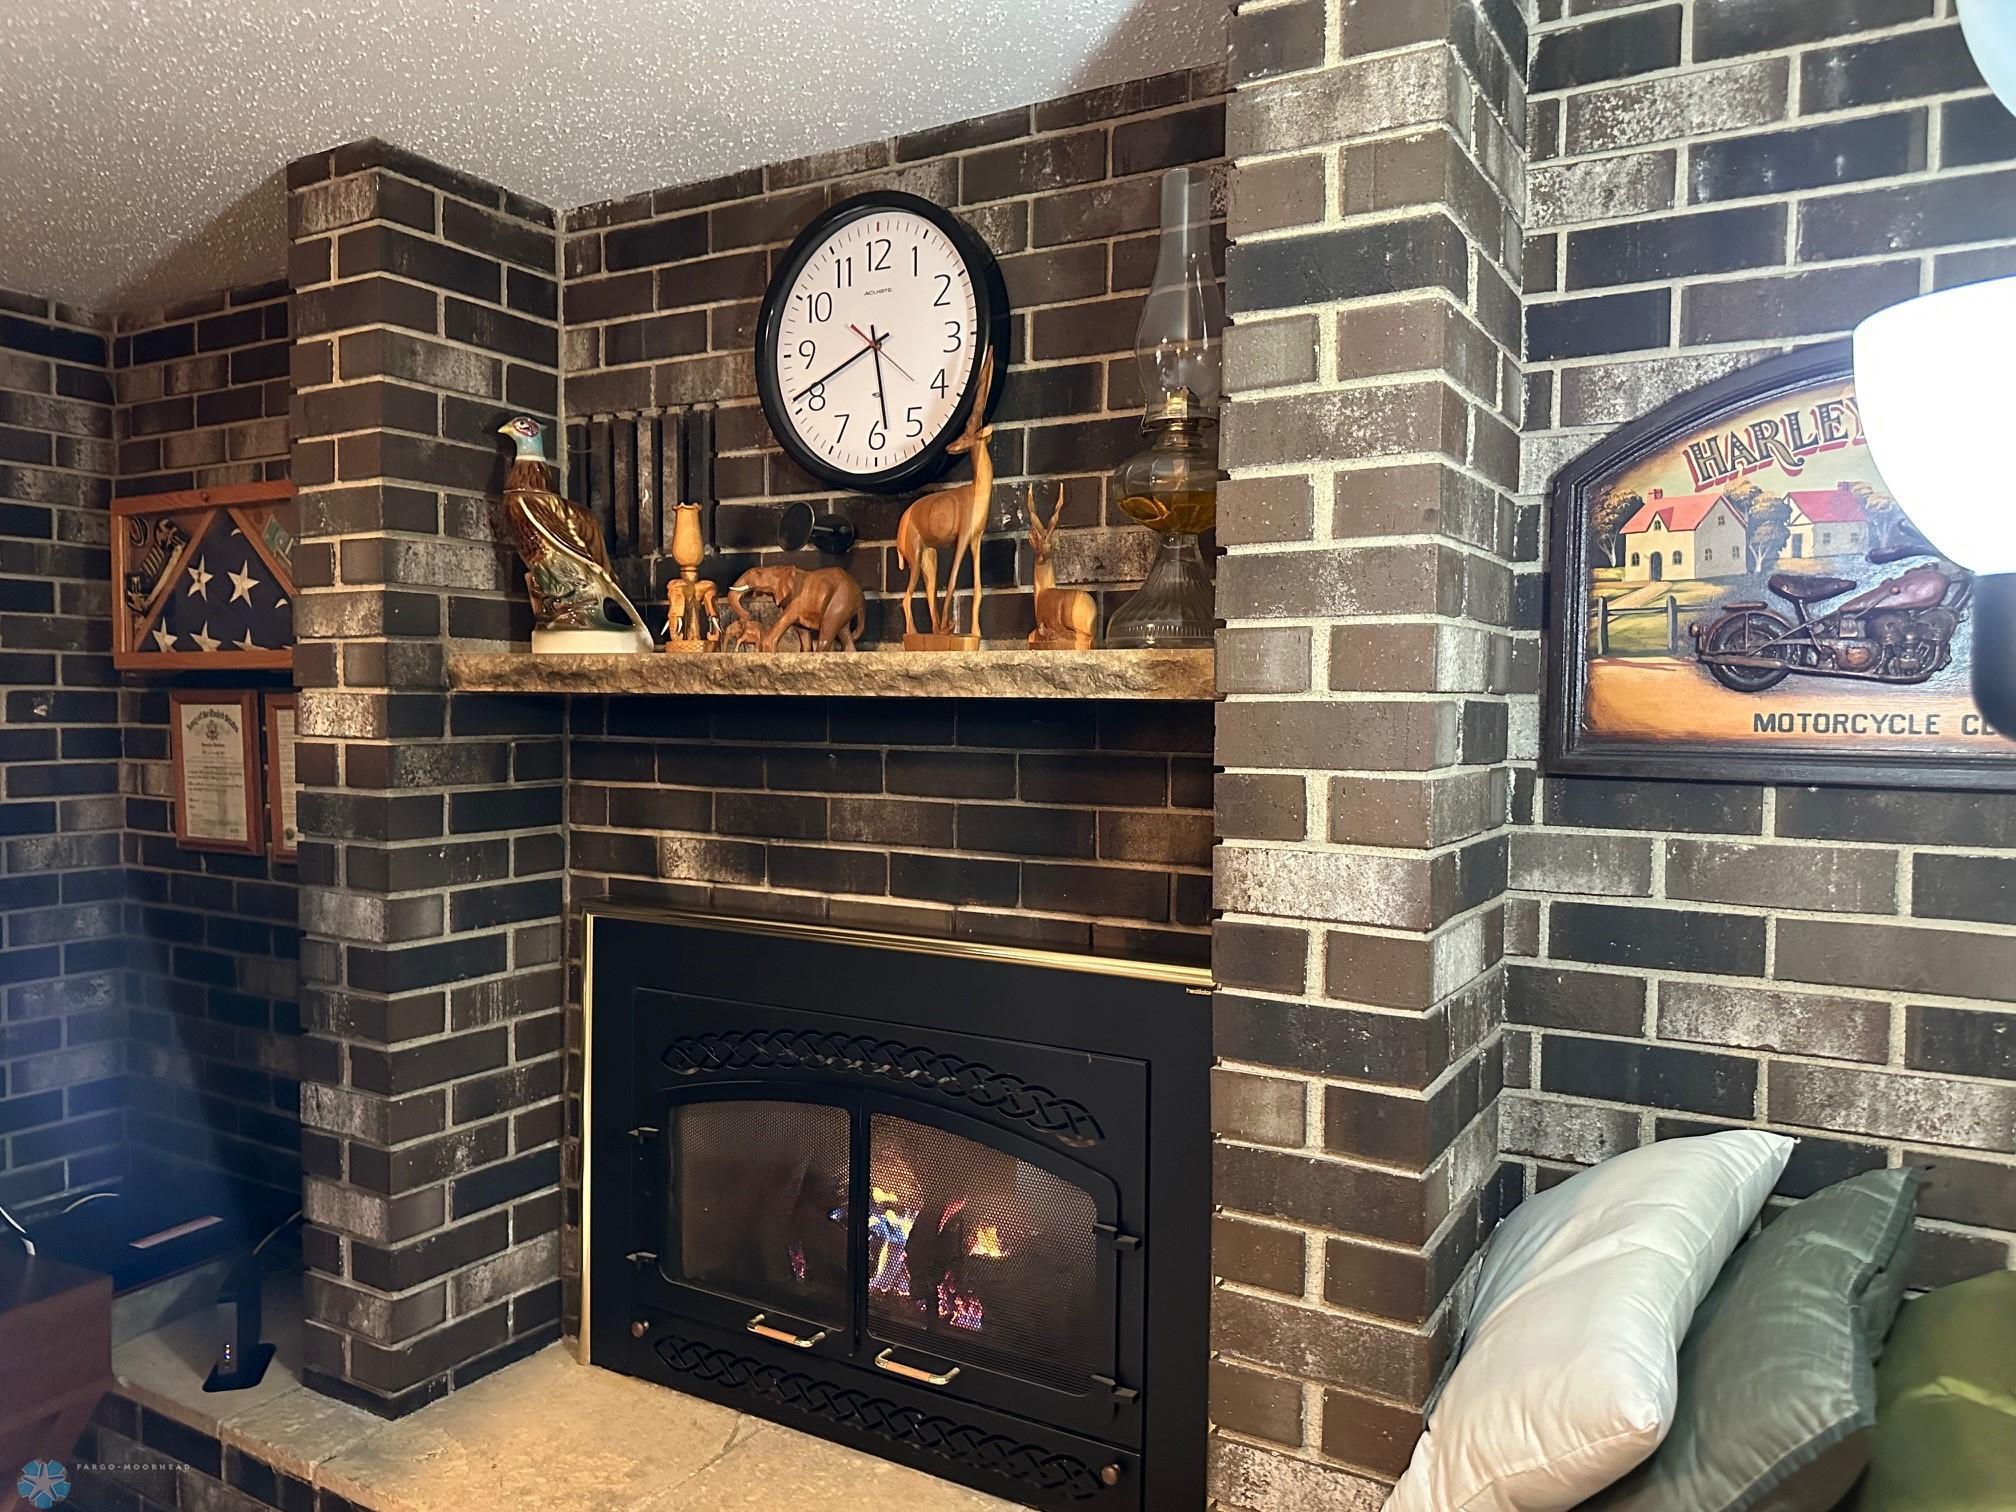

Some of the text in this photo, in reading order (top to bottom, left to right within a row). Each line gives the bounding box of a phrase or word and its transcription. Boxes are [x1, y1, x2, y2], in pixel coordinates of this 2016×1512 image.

[866, 239, 892, 272] 12
[911, 245, 918, 277] 1
[834, 256, 853, 289] 11
[933, 274, 951, 307] 2
[806, 292, 833, 324] 10
[943, 321, 962, 353] 3
[798, 340, 816, 370] 9
[807, 381, 826, 411] 8
[930, 368, 949, 399] 4
[834, 414, 850, 444] 7
[867, 420, 886, 451] 6
[906, 406, 924, 438] 5
[1753, 713, 1941, 736] MOTORCYCLE
